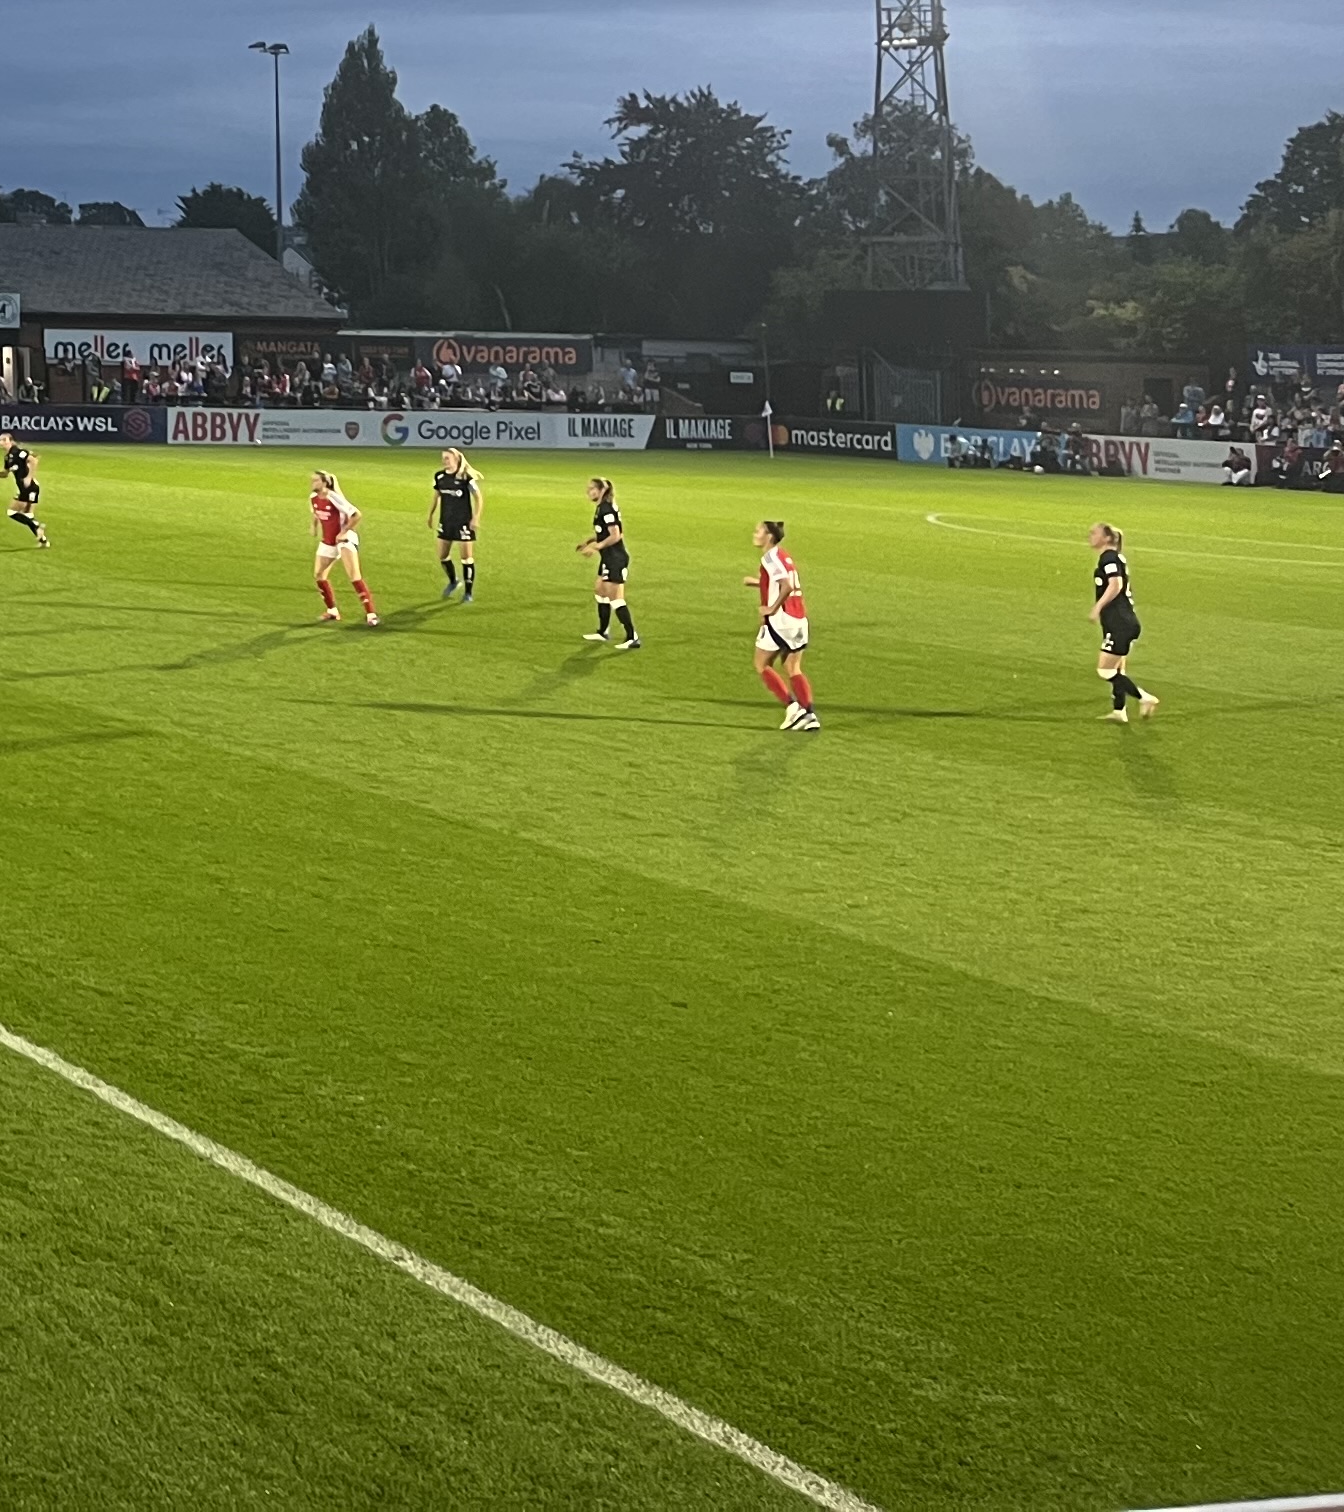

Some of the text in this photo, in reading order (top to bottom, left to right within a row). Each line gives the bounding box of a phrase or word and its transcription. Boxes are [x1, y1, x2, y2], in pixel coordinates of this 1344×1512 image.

[463, 345, 577, 364] vanarama
[997, 389, 1100, 410] vanarama
[0, 415, 118, 432] BARCLAYS WSL
[172, 411, 260, 442] ABBYY
[417, 419, 491, 446] Google
[497, 420, 541, 441] Pixel
[567, 418, 634, 438] IL MAKIAGE
[666, 418, 733, 439] IL MAKIAGE
[791, 427, 892, 452] mastercard
